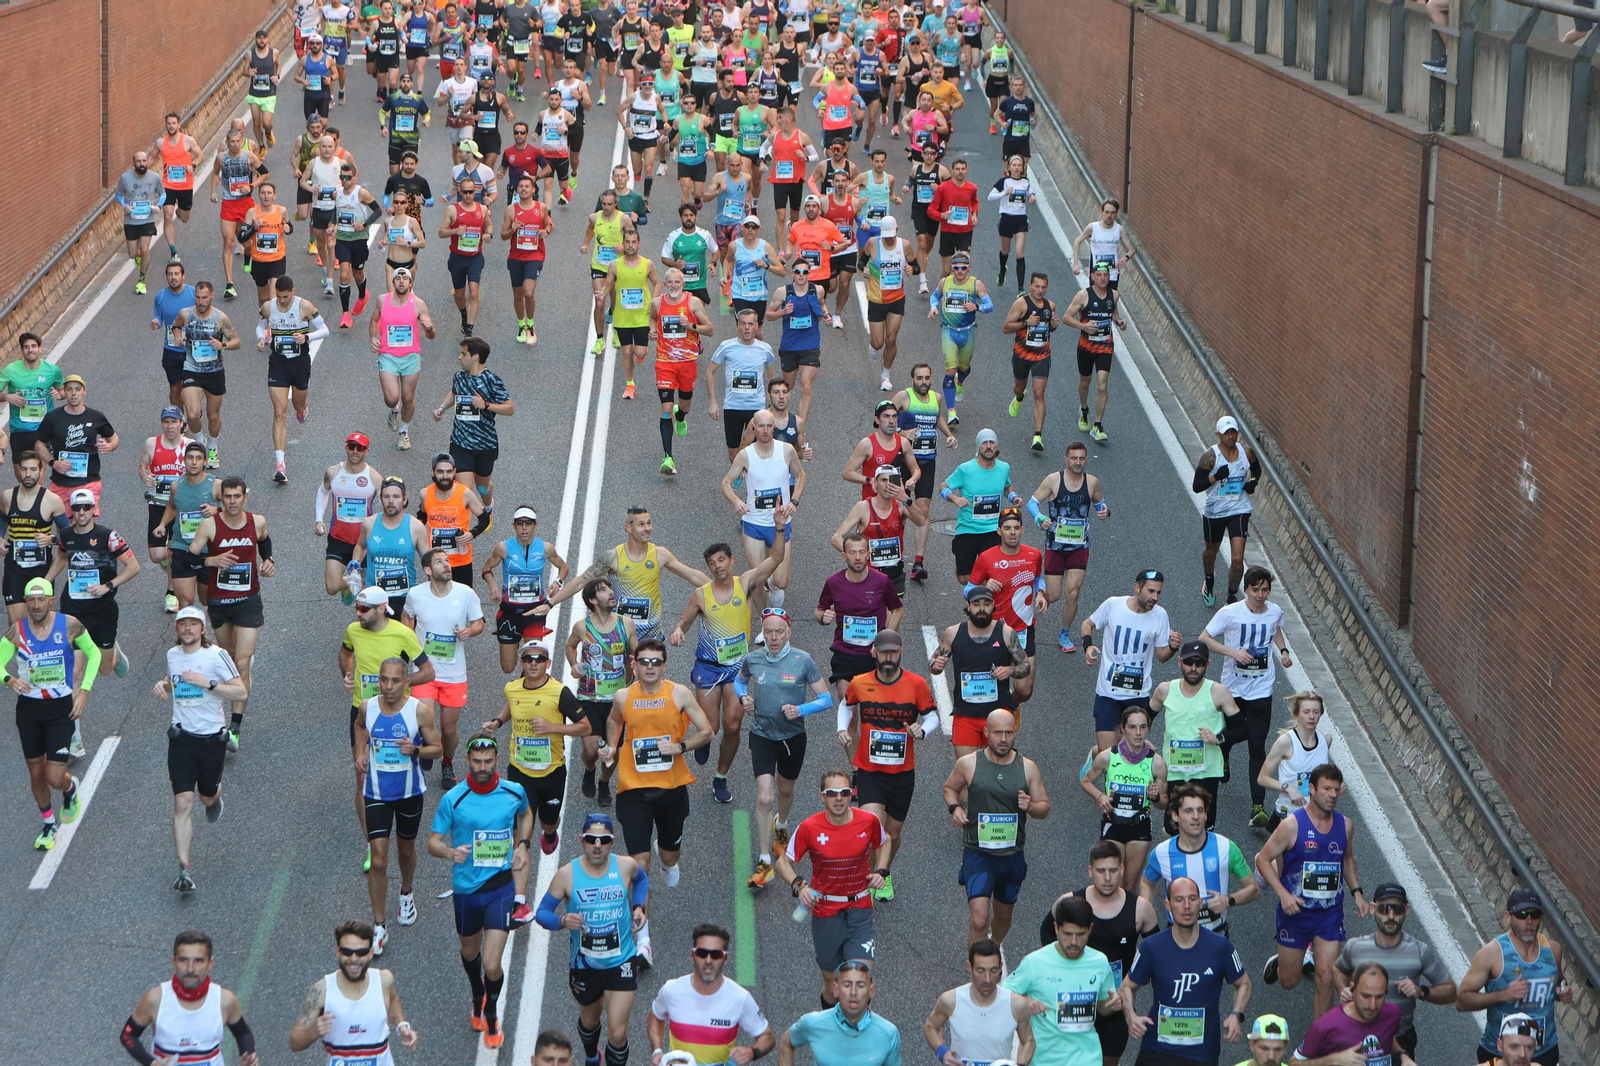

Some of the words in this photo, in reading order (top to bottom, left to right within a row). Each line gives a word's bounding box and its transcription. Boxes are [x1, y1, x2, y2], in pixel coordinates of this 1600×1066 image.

[727, 636, 743, 645] ZURICH
[633, 699, 666, 709] NORMY
[601, 891, 623, 900] ULSA
[592, 925, 613, 934] ZURICH
[1073, 1007, 1085, 1015] 3111
